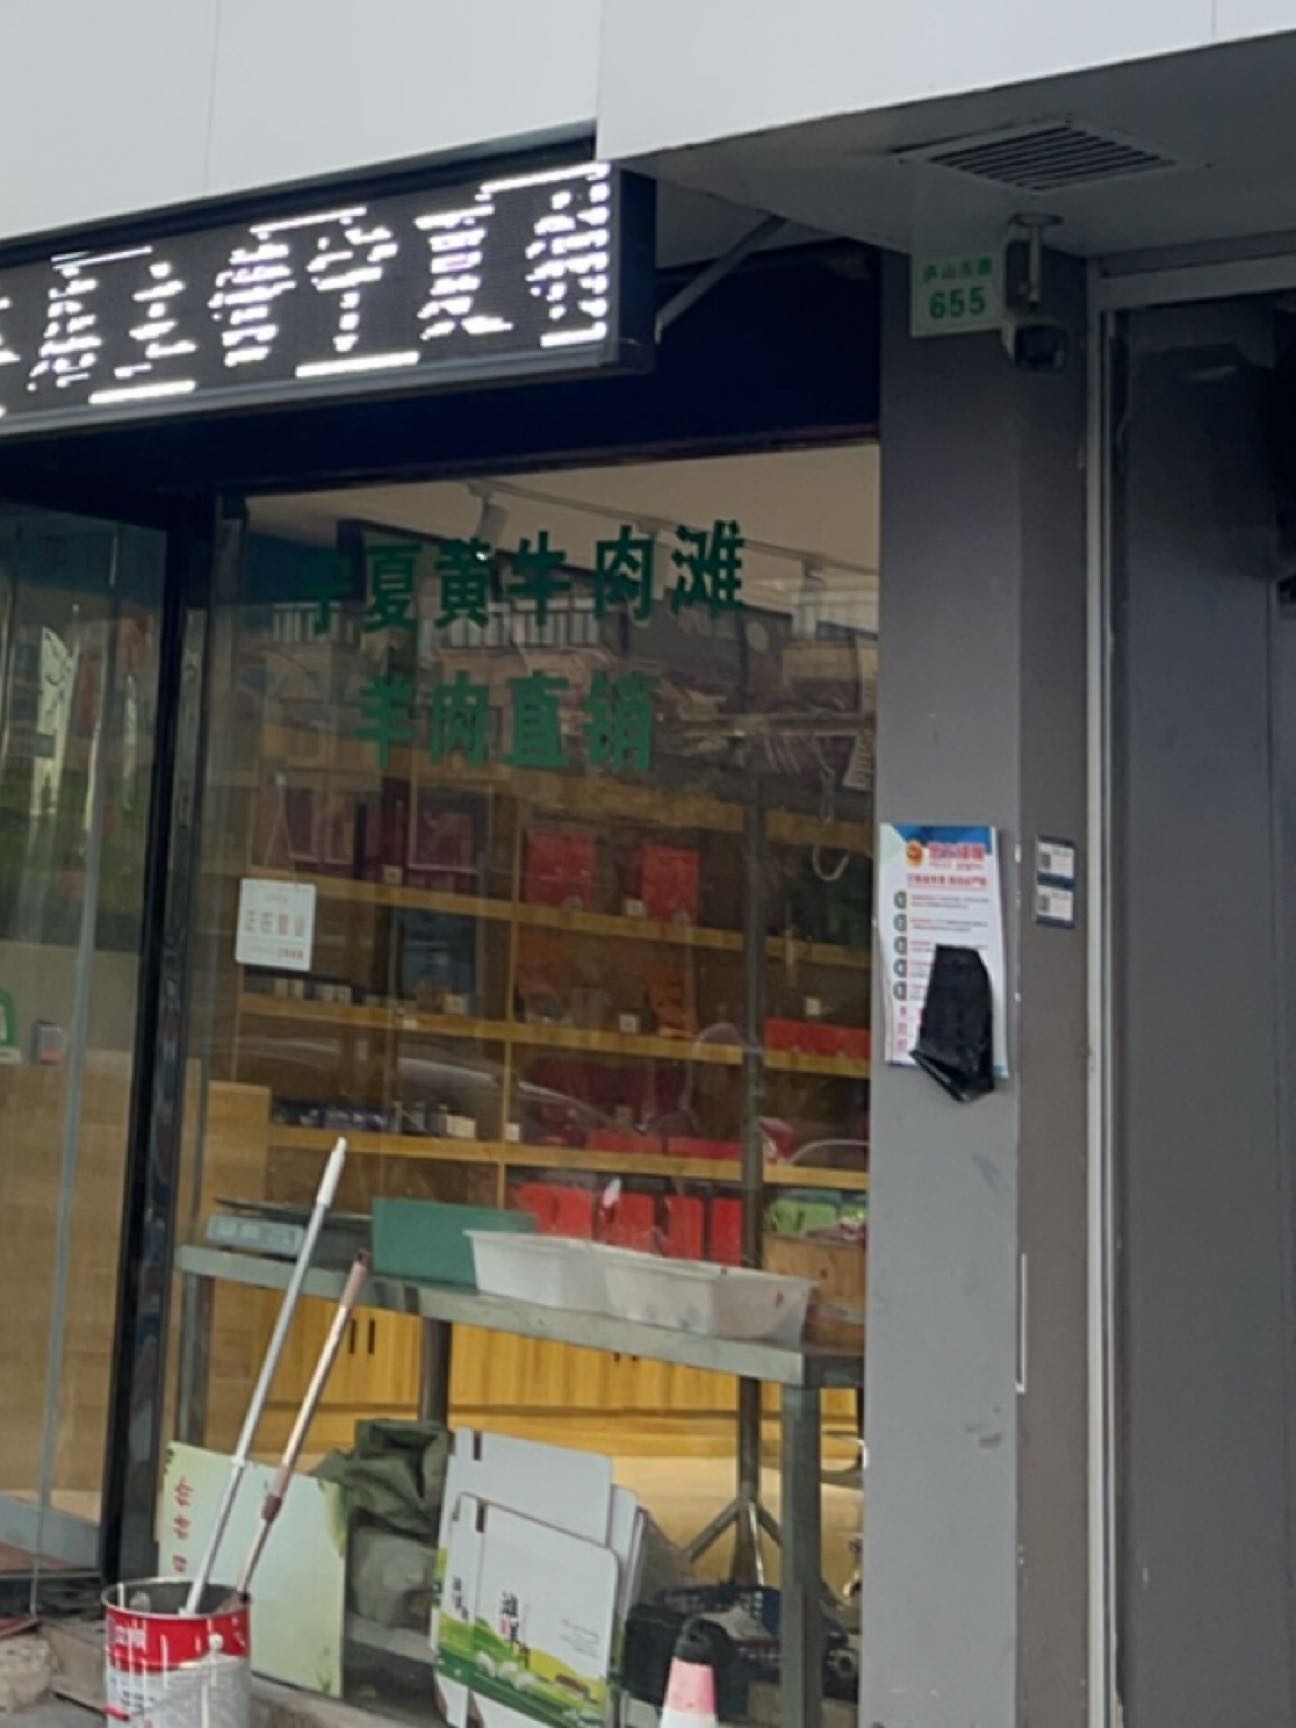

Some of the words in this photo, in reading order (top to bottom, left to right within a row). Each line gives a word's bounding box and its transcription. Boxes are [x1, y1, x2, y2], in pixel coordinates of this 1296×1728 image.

[929, 287, 987, 320] 655
[354, 670, 657, 772] 羊肉直销
